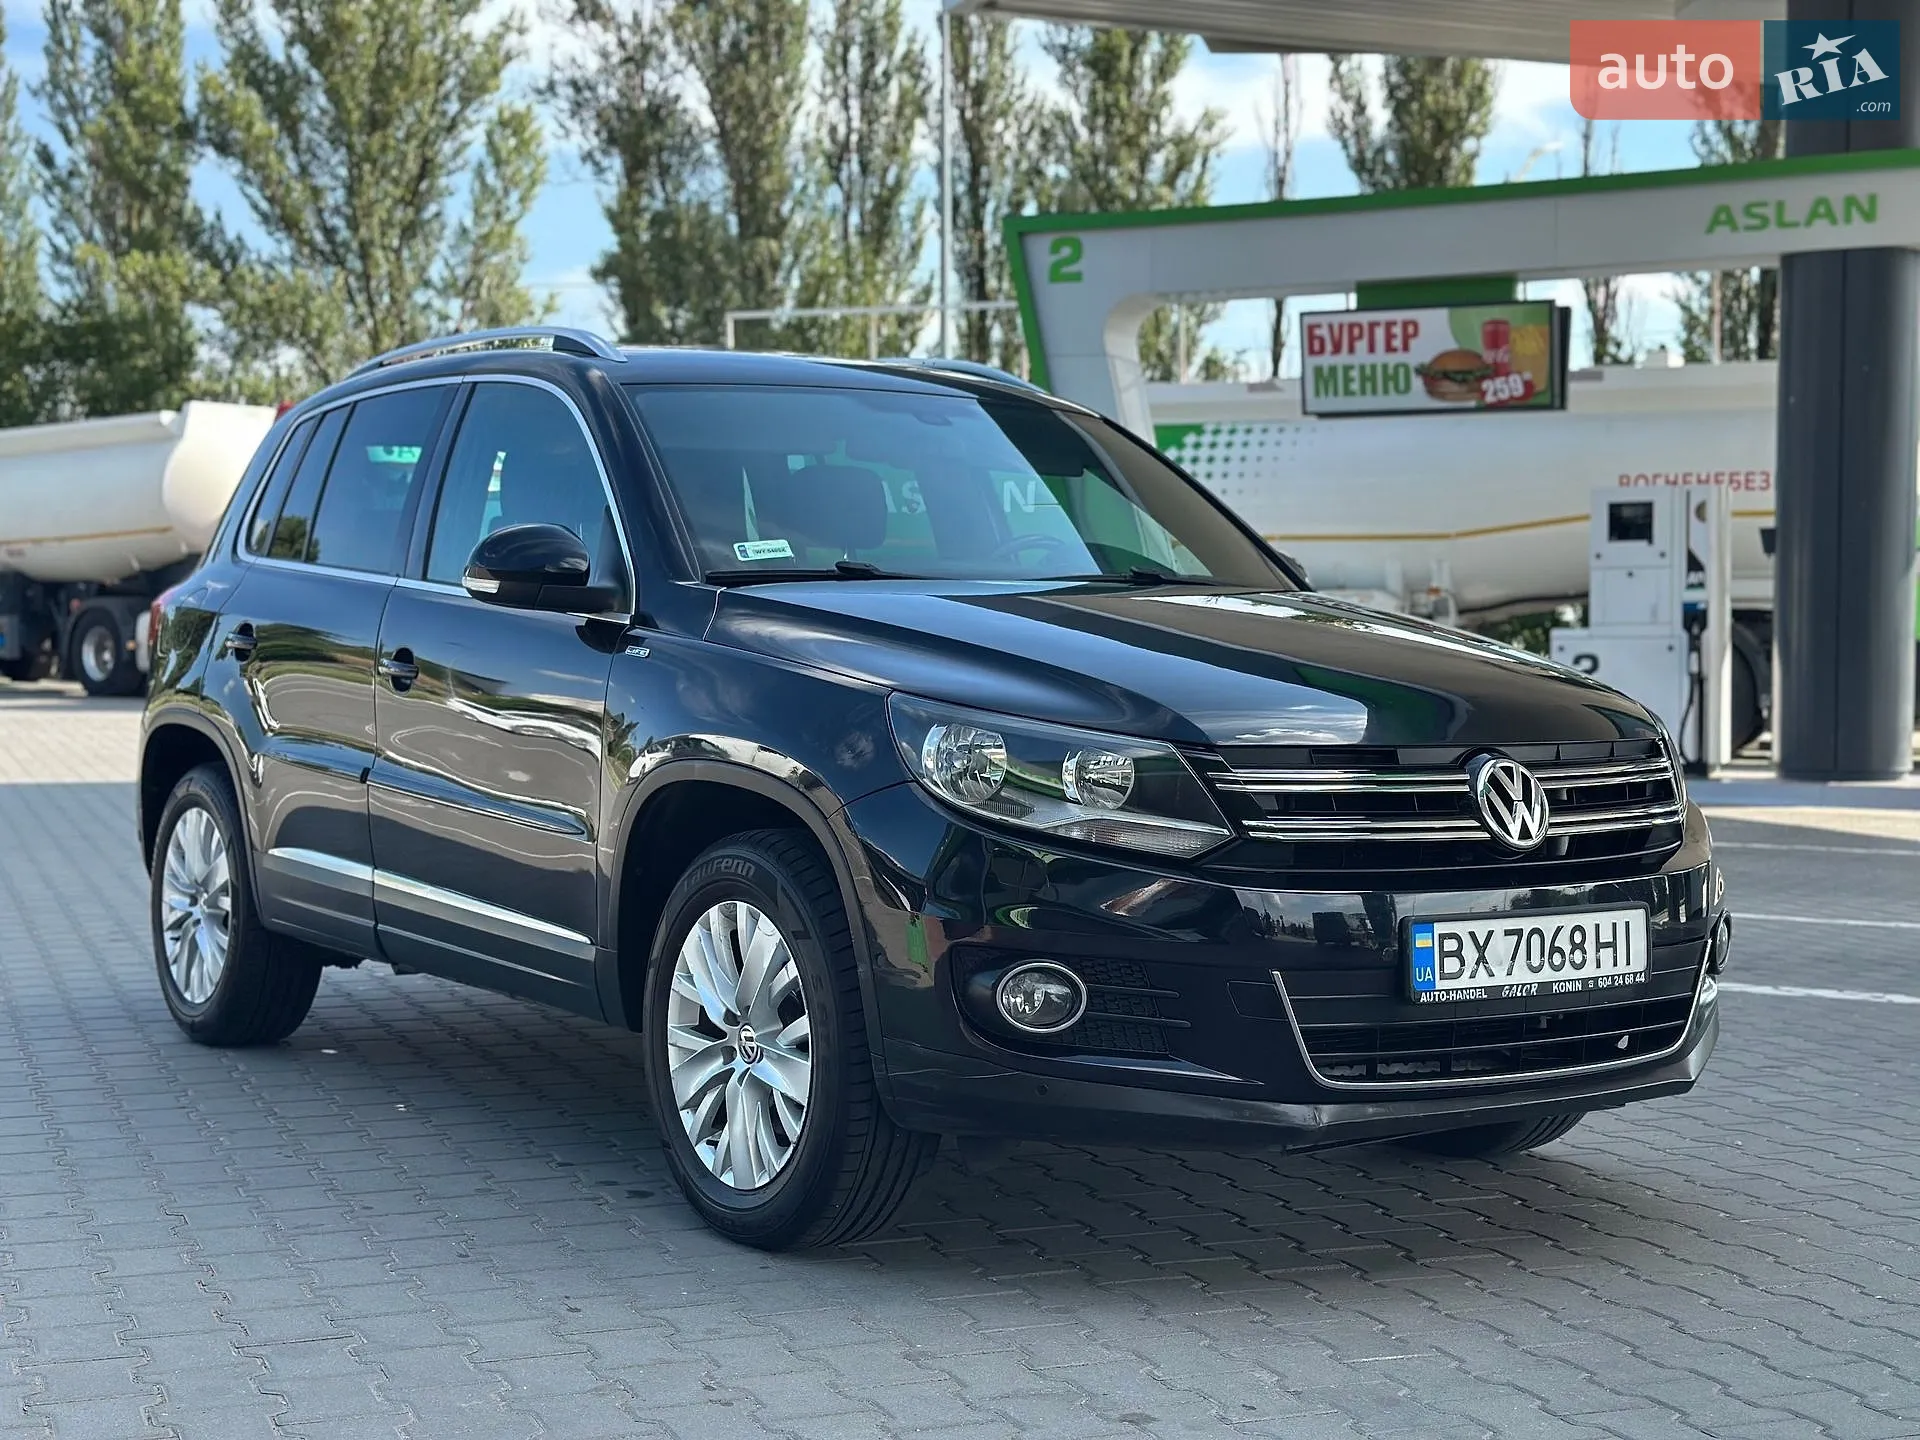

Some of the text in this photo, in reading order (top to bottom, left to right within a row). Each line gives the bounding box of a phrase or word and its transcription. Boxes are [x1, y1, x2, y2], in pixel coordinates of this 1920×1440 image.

[1705, 193, 1878, 235] ASLAN
[1049, 236, 1083, 283] 2
[1307, 319, 1419, 355] БУРГЕР
[1313, 362, 1411, 398] МЕНЮ
[1481, 373, 1525, 403] 259
[1438, 929, 1495, 980] BX
[1503, 924, 1587, 976] 7068
[1415, 966, 1434, 982] UA
[1420, 988, 1488, 1003] AUTO-HANDEL
[1552, 979, 1582, 994] KONIN
[1598, 976, 1612, 988] 604
[1614, 974, 1623, 986] 24
[1625, 973, 1634, 984] 68
[1635, 971, 1645, 983] 44
